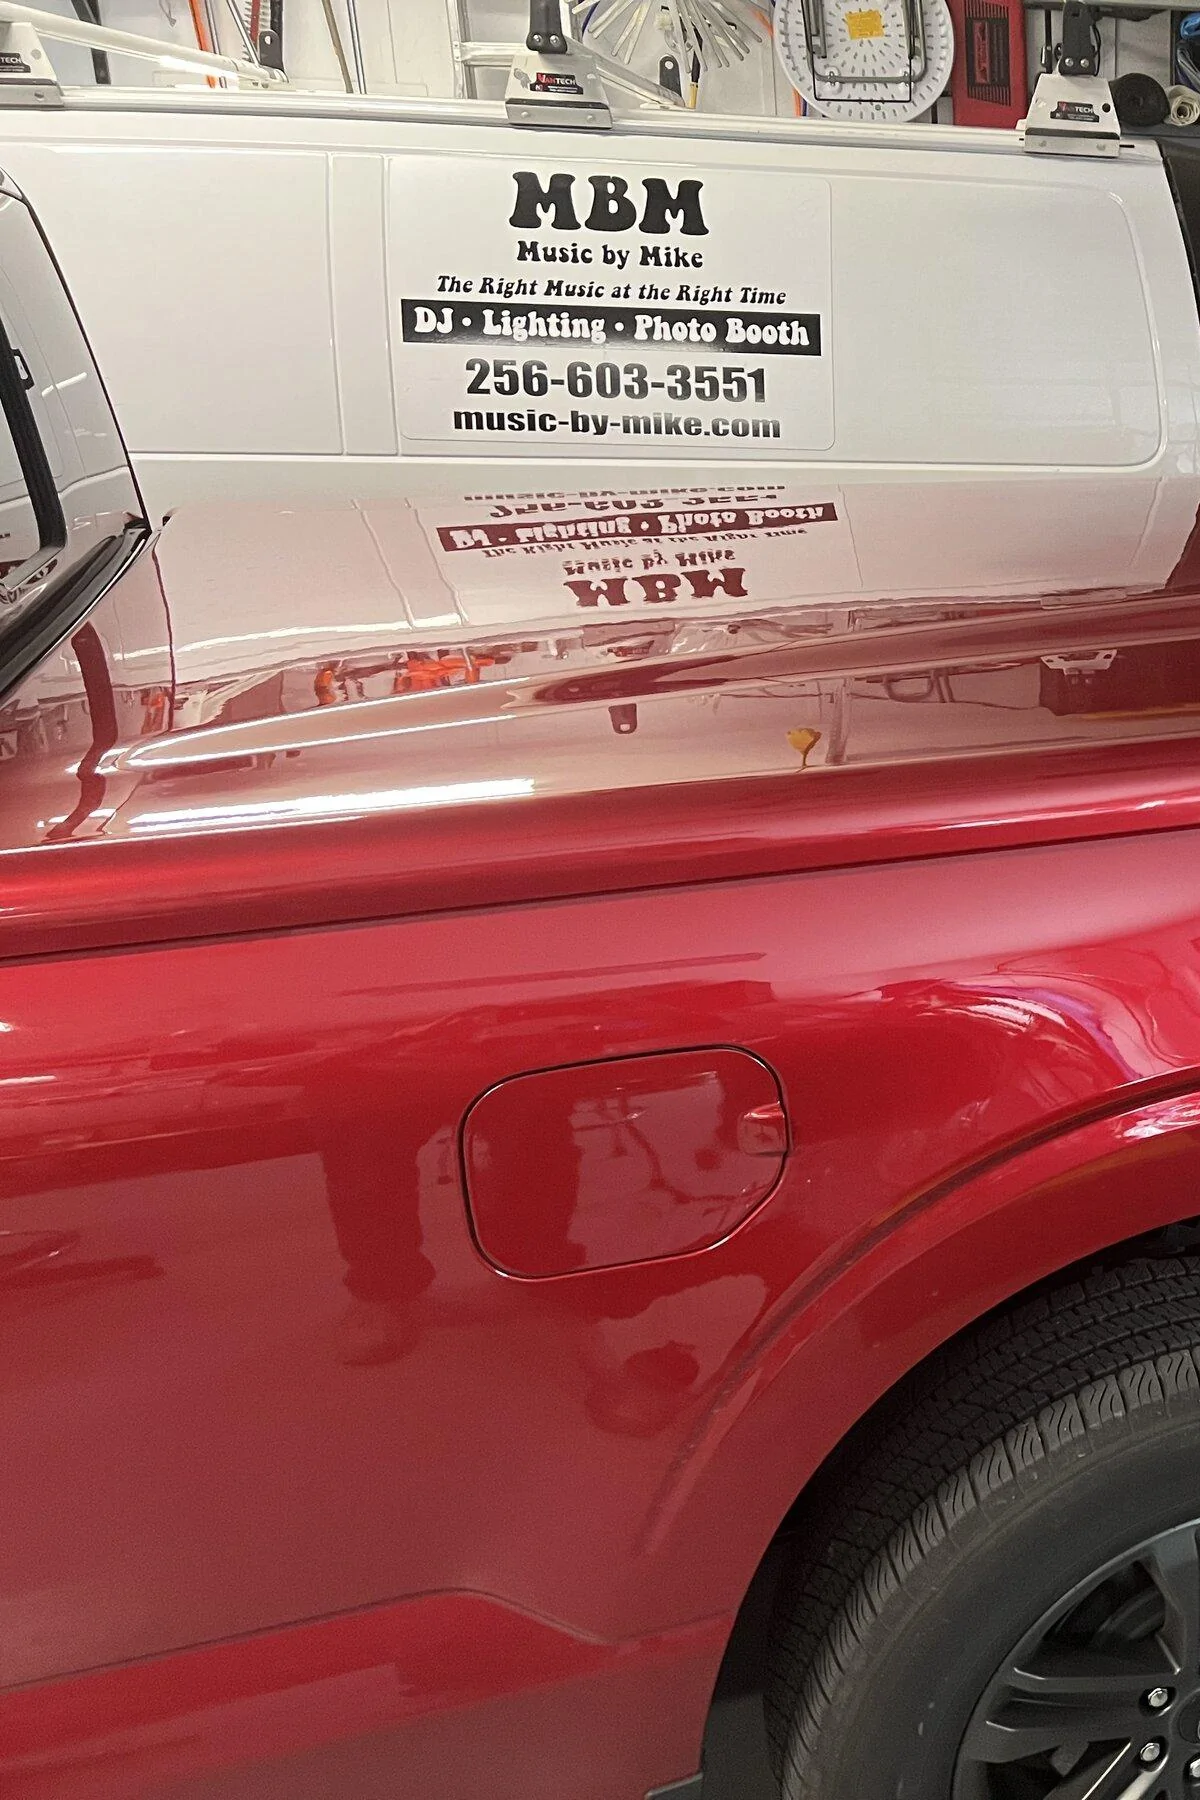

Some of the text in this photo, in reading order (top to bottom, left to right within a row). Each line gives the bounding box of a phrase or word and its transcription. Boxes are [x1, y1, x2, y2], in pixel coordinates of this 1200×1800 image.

[509, 171, 709, 236] MBM
[516, 240, 704, 269] Music by Mike
[437, 275, 787, 305] The Right Music at the Right Time
[413, 306, 810, 347] DJ Lighting Photo Booth
[465, 357, 766, 403] 256-603-3551
[453, 409, 782, 438] music-by-mike.com
